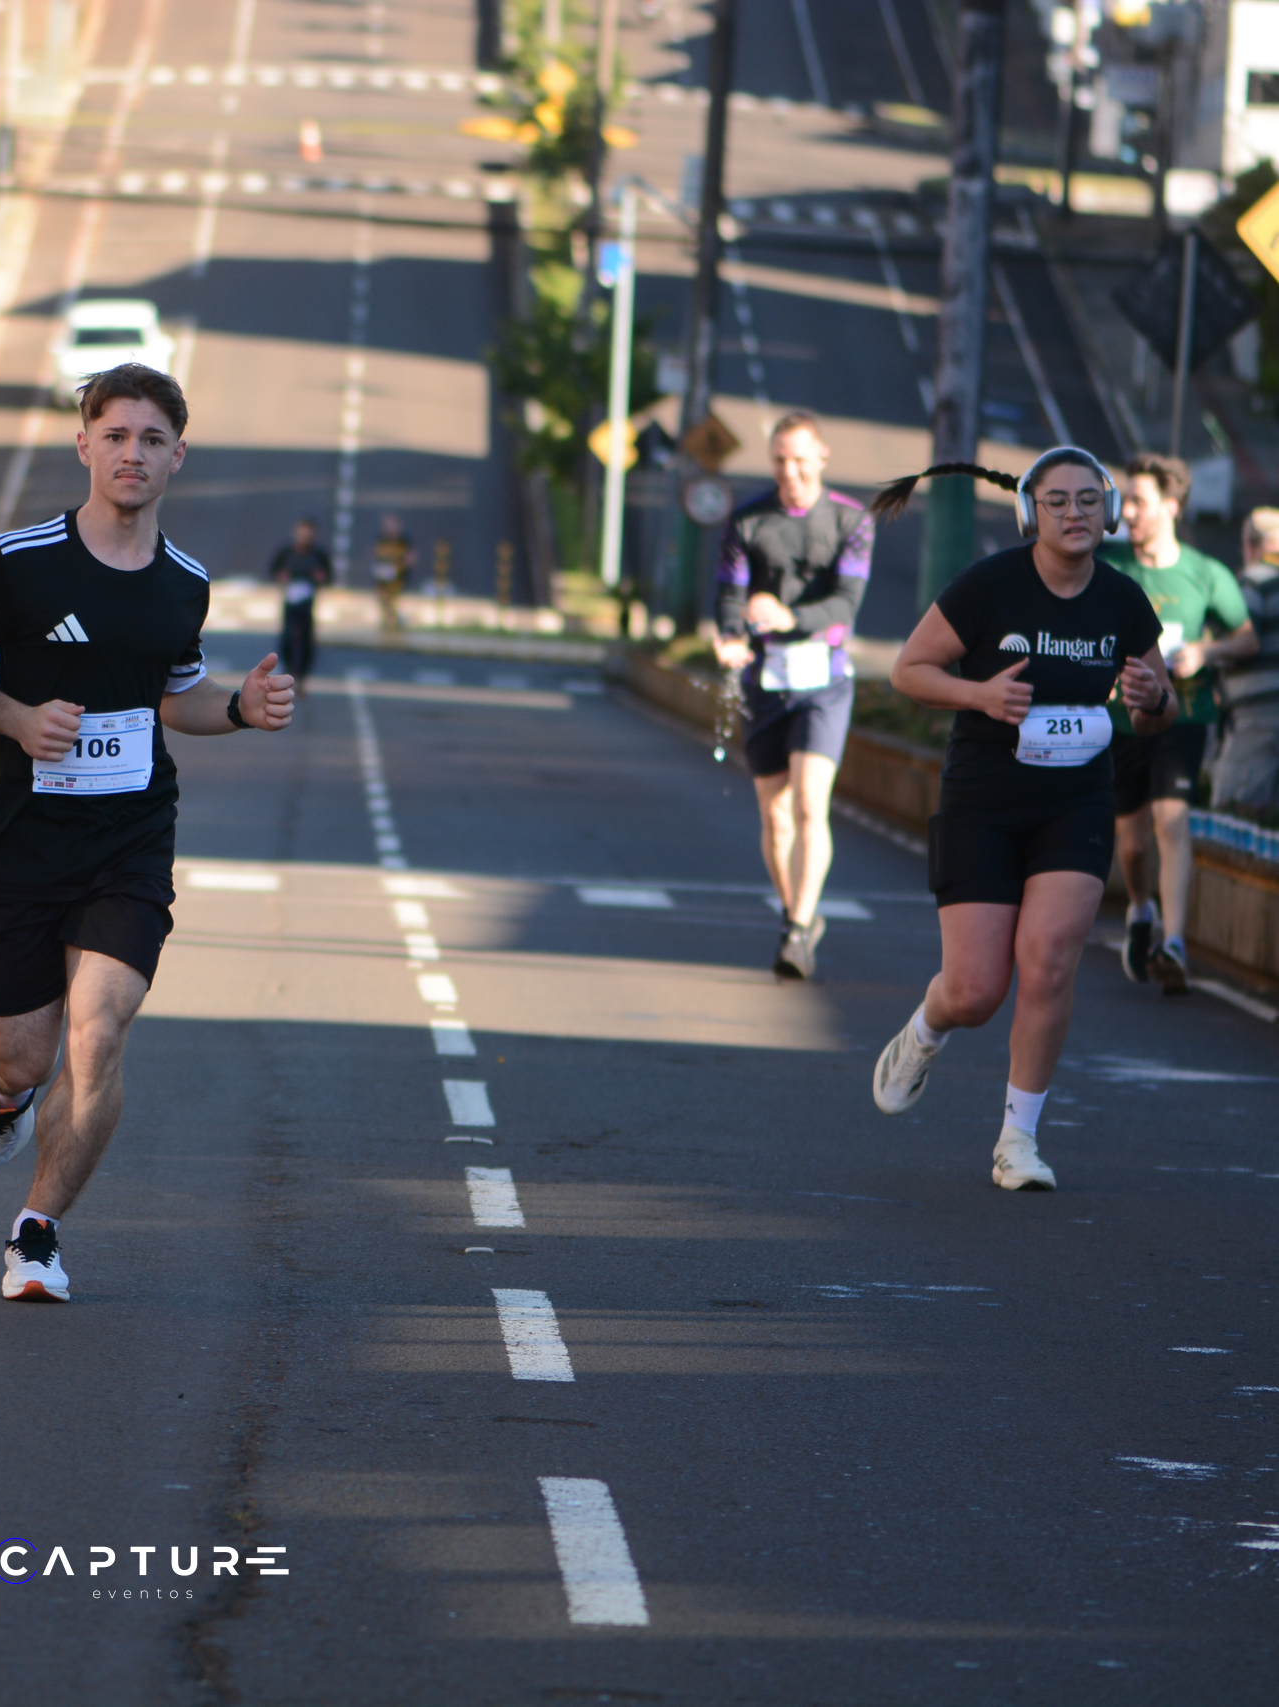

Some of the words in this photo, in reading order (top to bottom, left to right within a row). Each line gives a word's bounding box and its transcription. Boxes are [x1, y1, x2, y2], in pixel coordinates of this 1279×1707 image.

[1036, 631, 1096, 662] Hangar
[1100, 635, 1117, 658] 67
[1046, 718, 1083, 735] 281
[73, 737, 121, 758] 106
